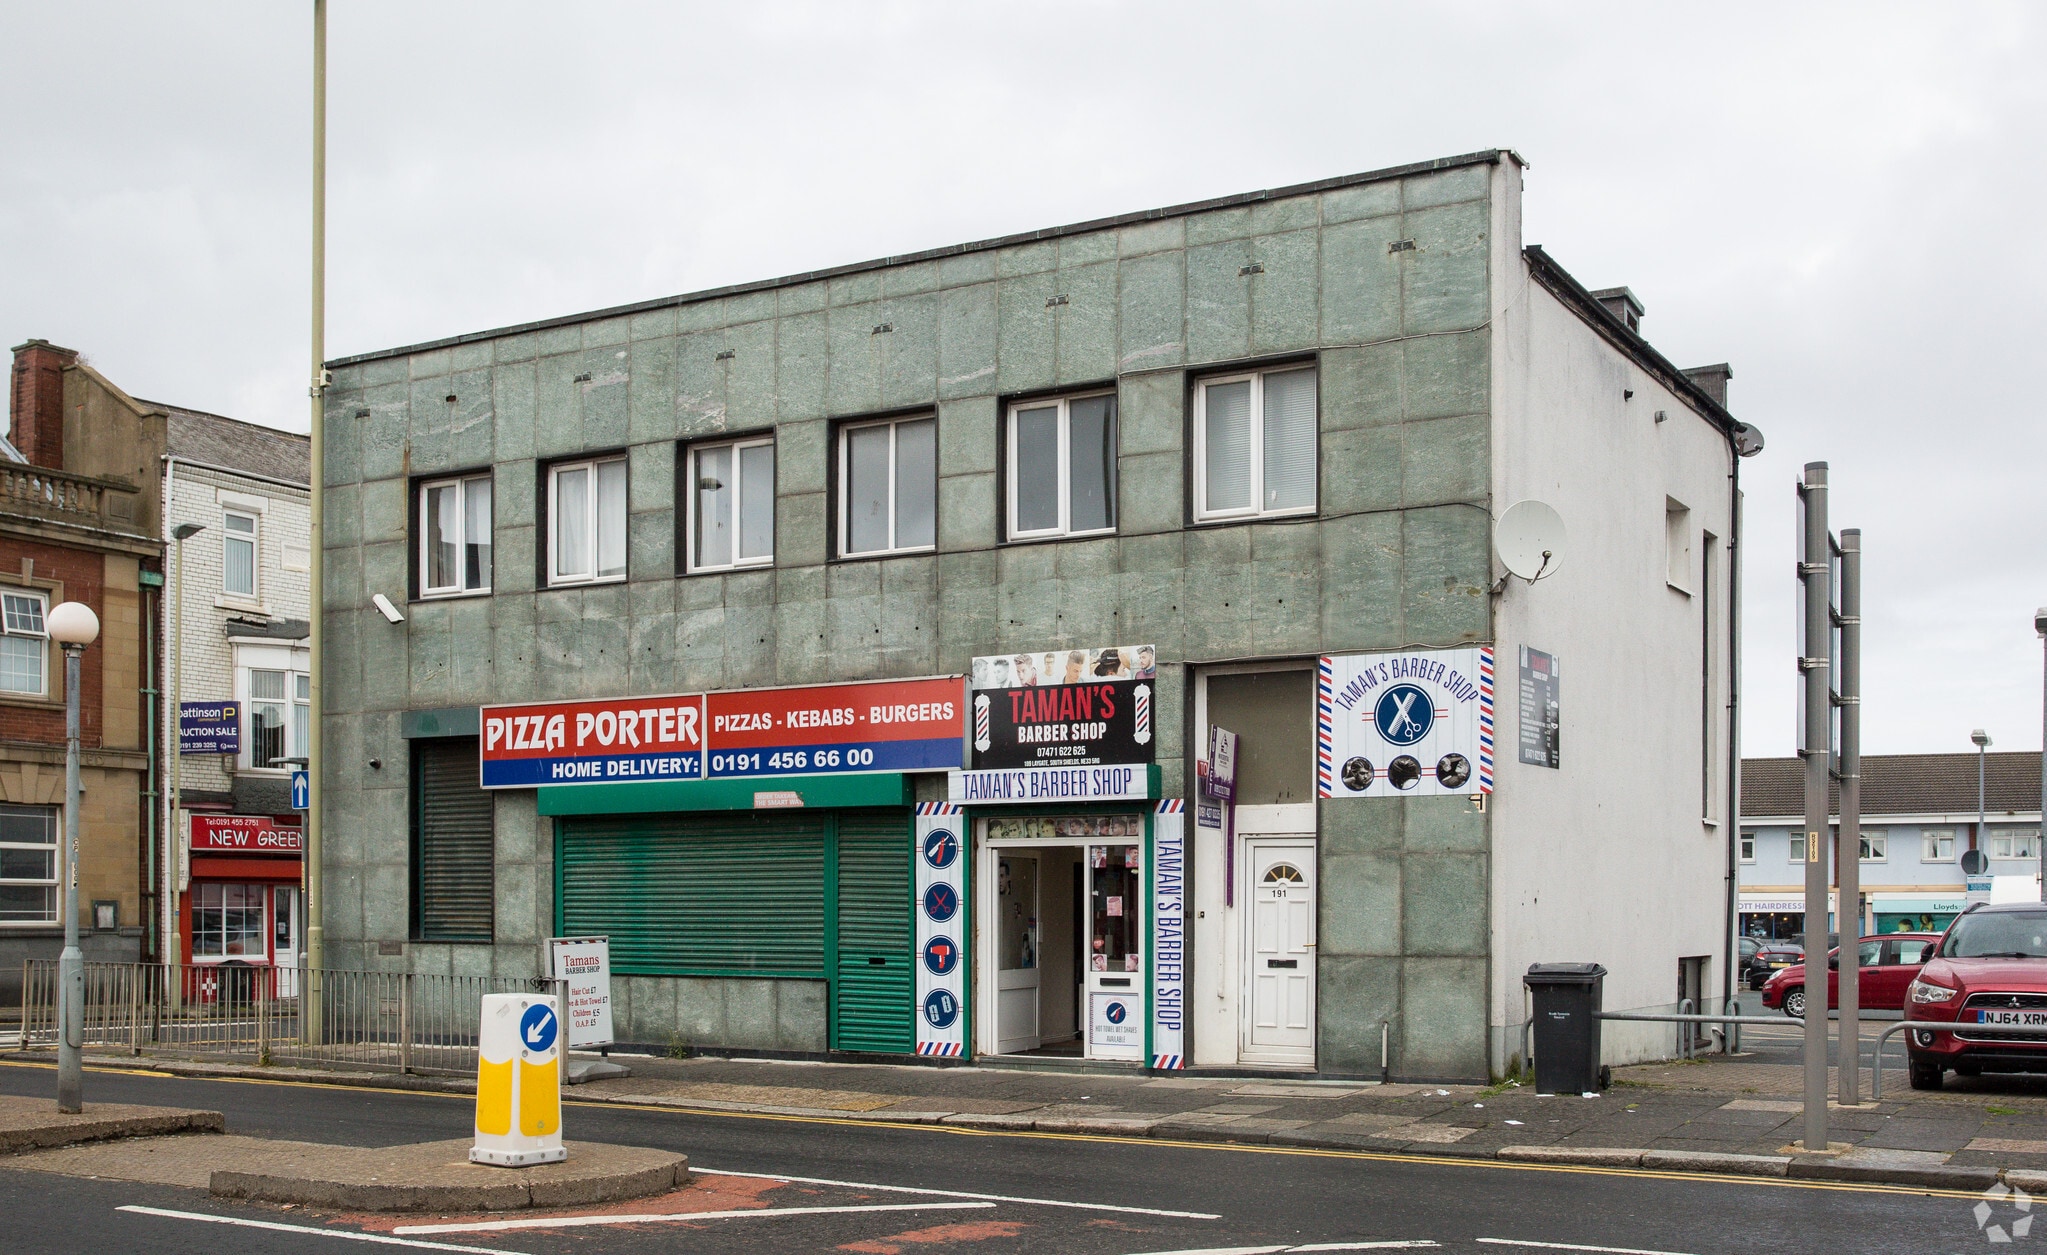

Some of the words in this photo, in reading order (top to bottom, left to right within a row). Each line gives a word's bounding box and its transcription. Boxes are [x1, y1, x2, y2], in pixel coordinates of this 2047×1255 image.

[1334, 662, 1389, 712] TAMAN'S
[1391, 657, 1446, 684] BARBER
[1443, 669, 1479, 704] SHOP
[1008, 684, 1116, 724] TAMAN'S
[714, 712, 772, 732] PIZZAS
[787, 708, 854, 728] KEBABS
[870, 702, 953, 724] BURGERS
[216, 727, 237, 736] SALE
[486, 714, 566, 752] PIZZA
[576, 706, 700, 748] PORTER
[1018, 724, 1069, 744] BARBER
[1071, 722, 1107, 740] SHOP
[712, 753, 760, 771] 0191
[768, 752, 807, 769] 456
[814, 750, 840, 767] 66
[847, 748, 874, 766] 00
[1037, 747, 1057, 758] 07471
[1058, 746, 1071, 756] 622
[1073, 745, 1086, 756] 625
[552, 761, 601, 779] HOME
[607, 757, 699, 776] DELIVERY:
[963, 772, 1025, 800] TAMAN'S
[1030, 769, 1088, 798] BARBER
[1093, 768, 1132, 796] SHOP
[209, 829, 249, 846] NEW
[1158, 837, 1182, 911] TAMAN'S
[1272, 889, 1286, 897] 191
[1158, 917, 1182, 981] BARBER
[563, 955, 599, 967] Tamans
[565, 967, 586, 975] BARBER
[587, 965, 600, 973] SHOP
[572, 988, 581, 996] Hair
[582, 987, 590, 995] Cut
[591, 986, 596, 994] £7
[580, 998, 589, 1006] Hot
[589, 996, 602, 1005] Towel
[603, 996, 608, 1004] £7
[1157, 988, 1182, 1031] SHOP
[573, 1009, 591, 1018] Children
[593, 1009, 600, 1017] £5
[591, 1018, 596, 1027] £5
[1986, 1012, 2020, 1024] NJ64
[2024, 1013, 2047, 1025] XRM
